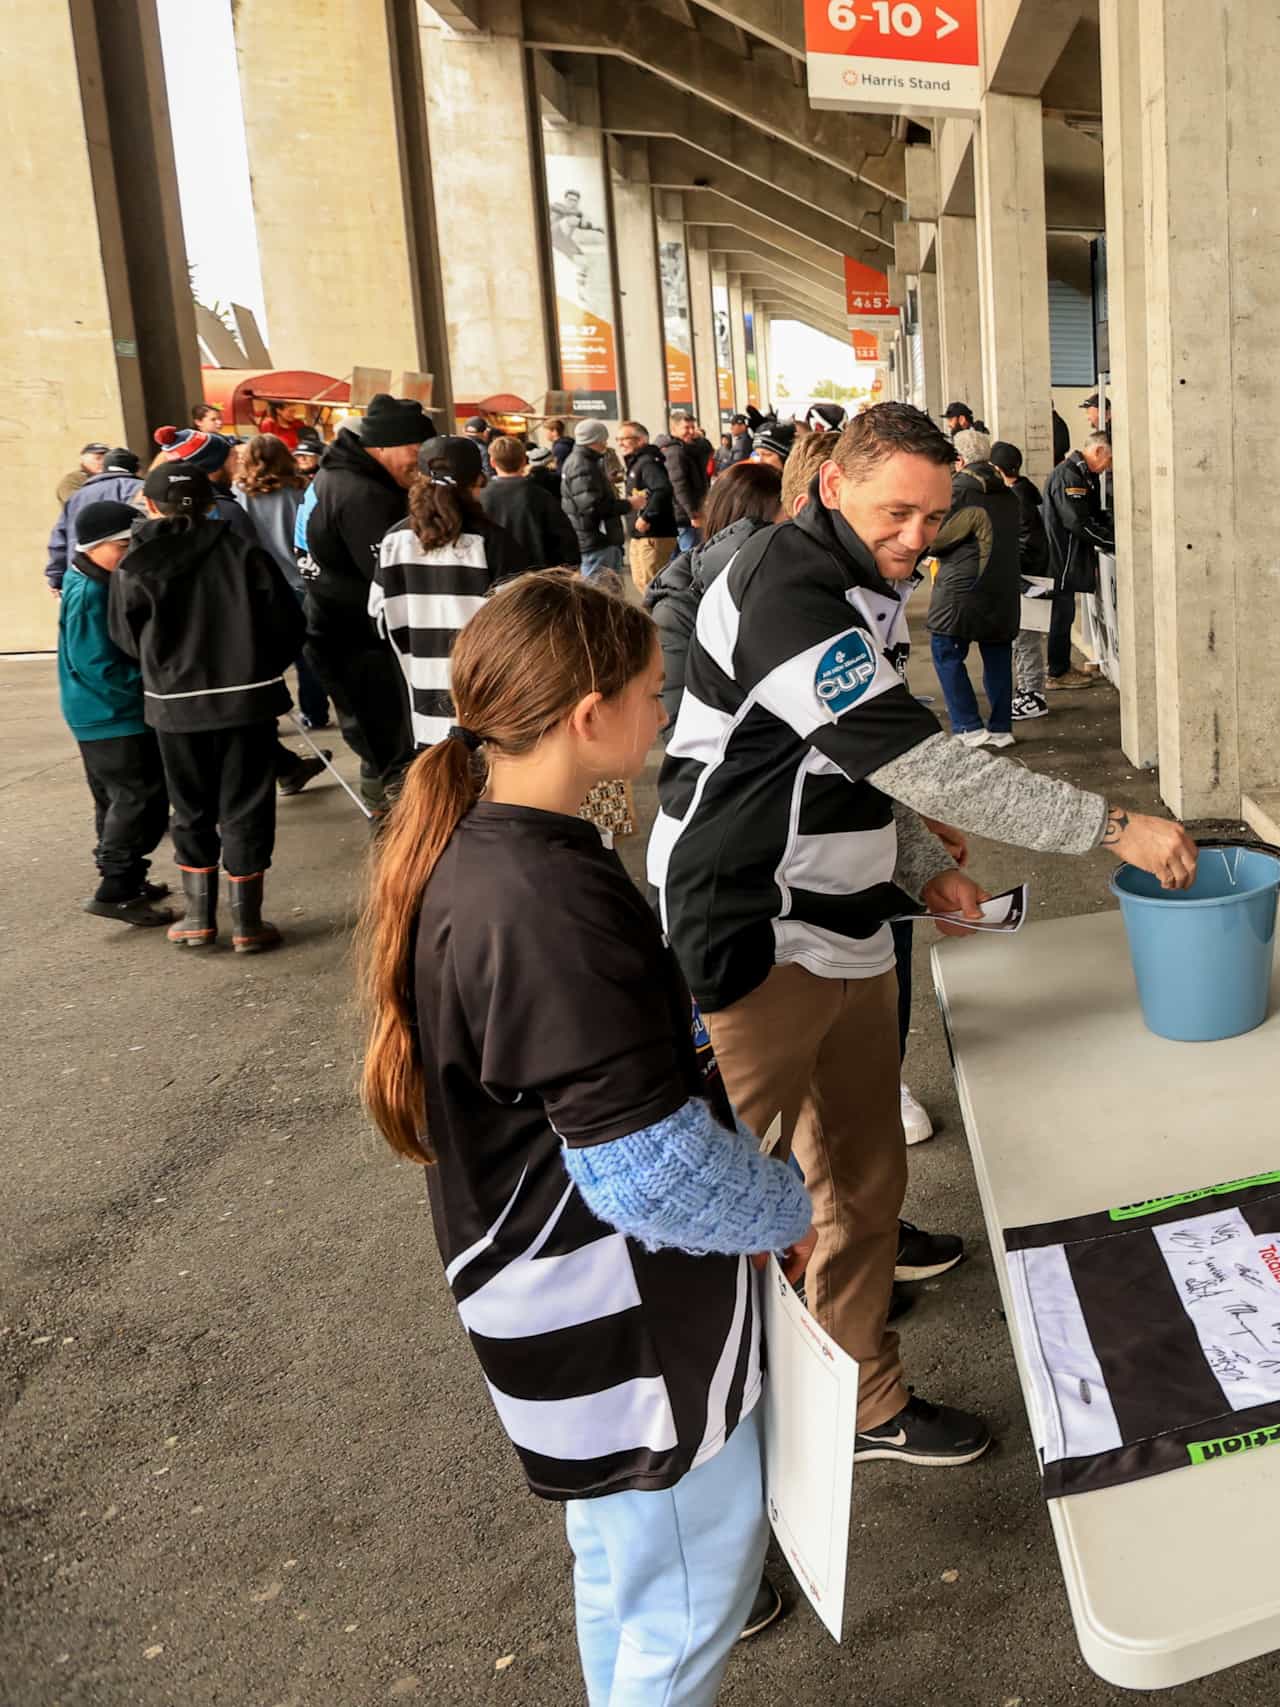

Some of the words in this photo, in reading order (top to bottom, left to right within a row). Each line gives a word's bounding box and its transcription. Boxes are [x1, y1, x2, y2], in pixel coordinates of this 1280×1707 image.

[827, 0, 922, 37] 6-10
[861, 73, 905, 88] Harris
[909, 77, 951, 91] Stand
[816, 661, 874, 700] CUP
